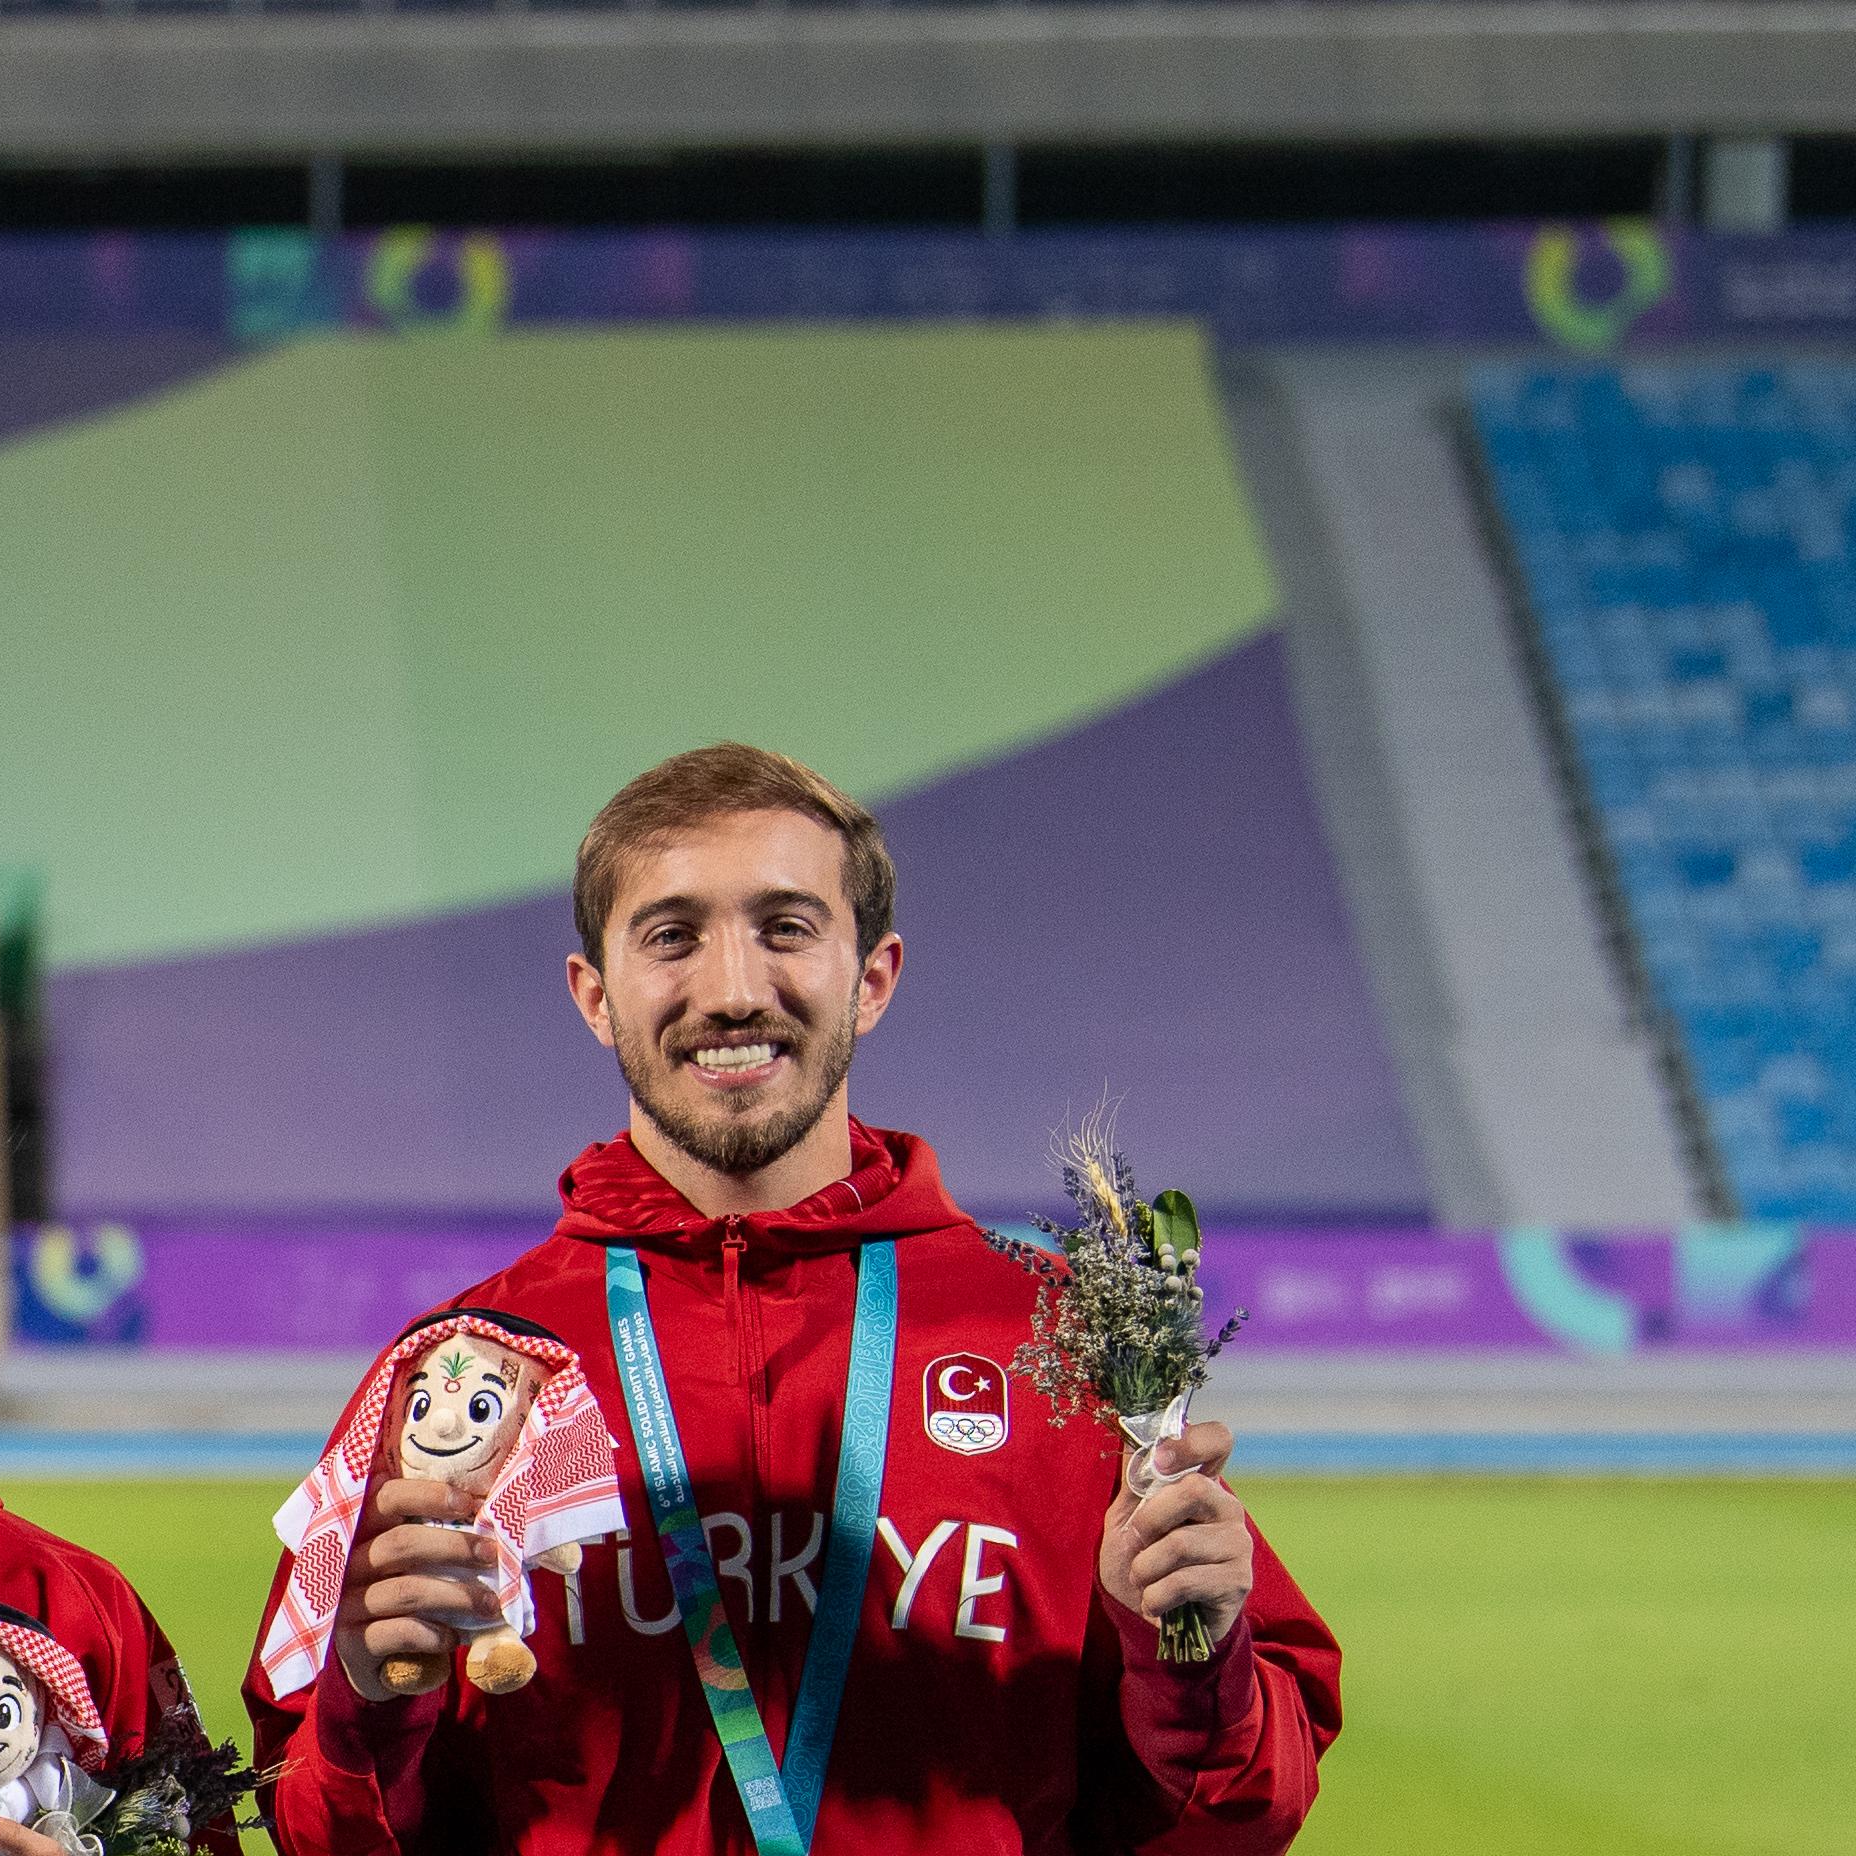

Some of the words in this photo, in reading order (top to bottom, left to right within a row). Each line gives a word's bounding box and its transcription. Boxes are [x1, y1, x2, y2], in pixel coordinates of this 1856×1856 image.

[618, 1317, 636, 1362] GAMES
[627, 1365, 654, 1438] SOLIDARITY
[645, 1440, 668, 1492] ISLAMIC
